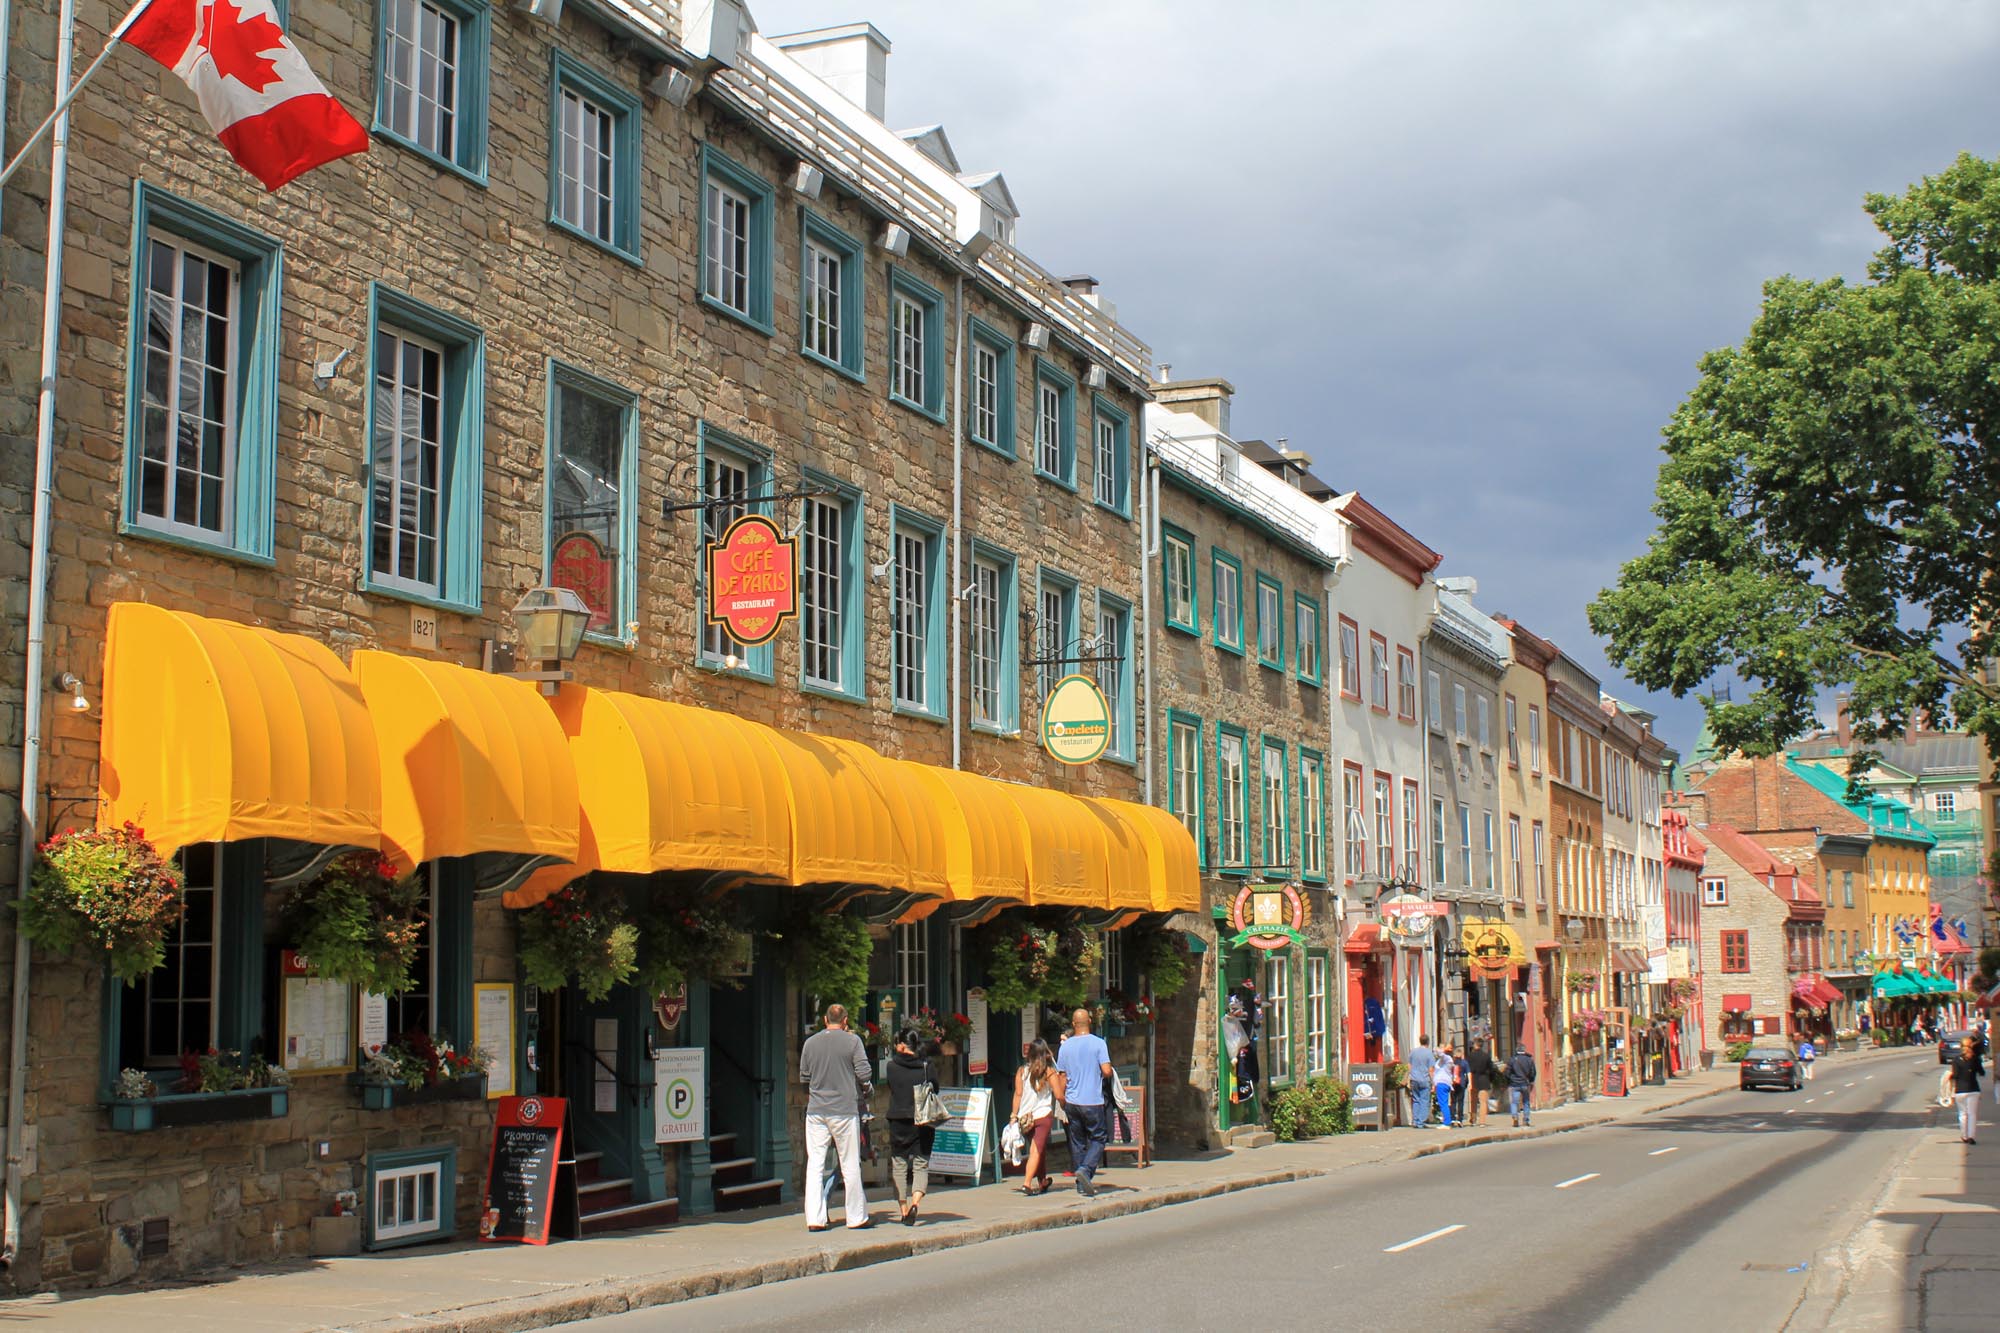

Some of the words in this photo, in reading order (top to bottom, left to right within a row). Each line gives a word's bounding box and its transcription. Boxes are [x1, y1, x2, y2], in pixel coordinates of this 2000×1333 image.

[718, 576, 739, 596] DE
[743, 571, 787, 594] PARIS
[731, 599, 775, 610] RESTAURANT
[413, 618, 434, 637] 1827
[1060, 738, 1093, 746] restaurant
[1352, 1072, 1378, 1081] HÔTEL
[675, 1089, 687, 1109] P
[662, 1121, 697, 1134] GRATUIT
